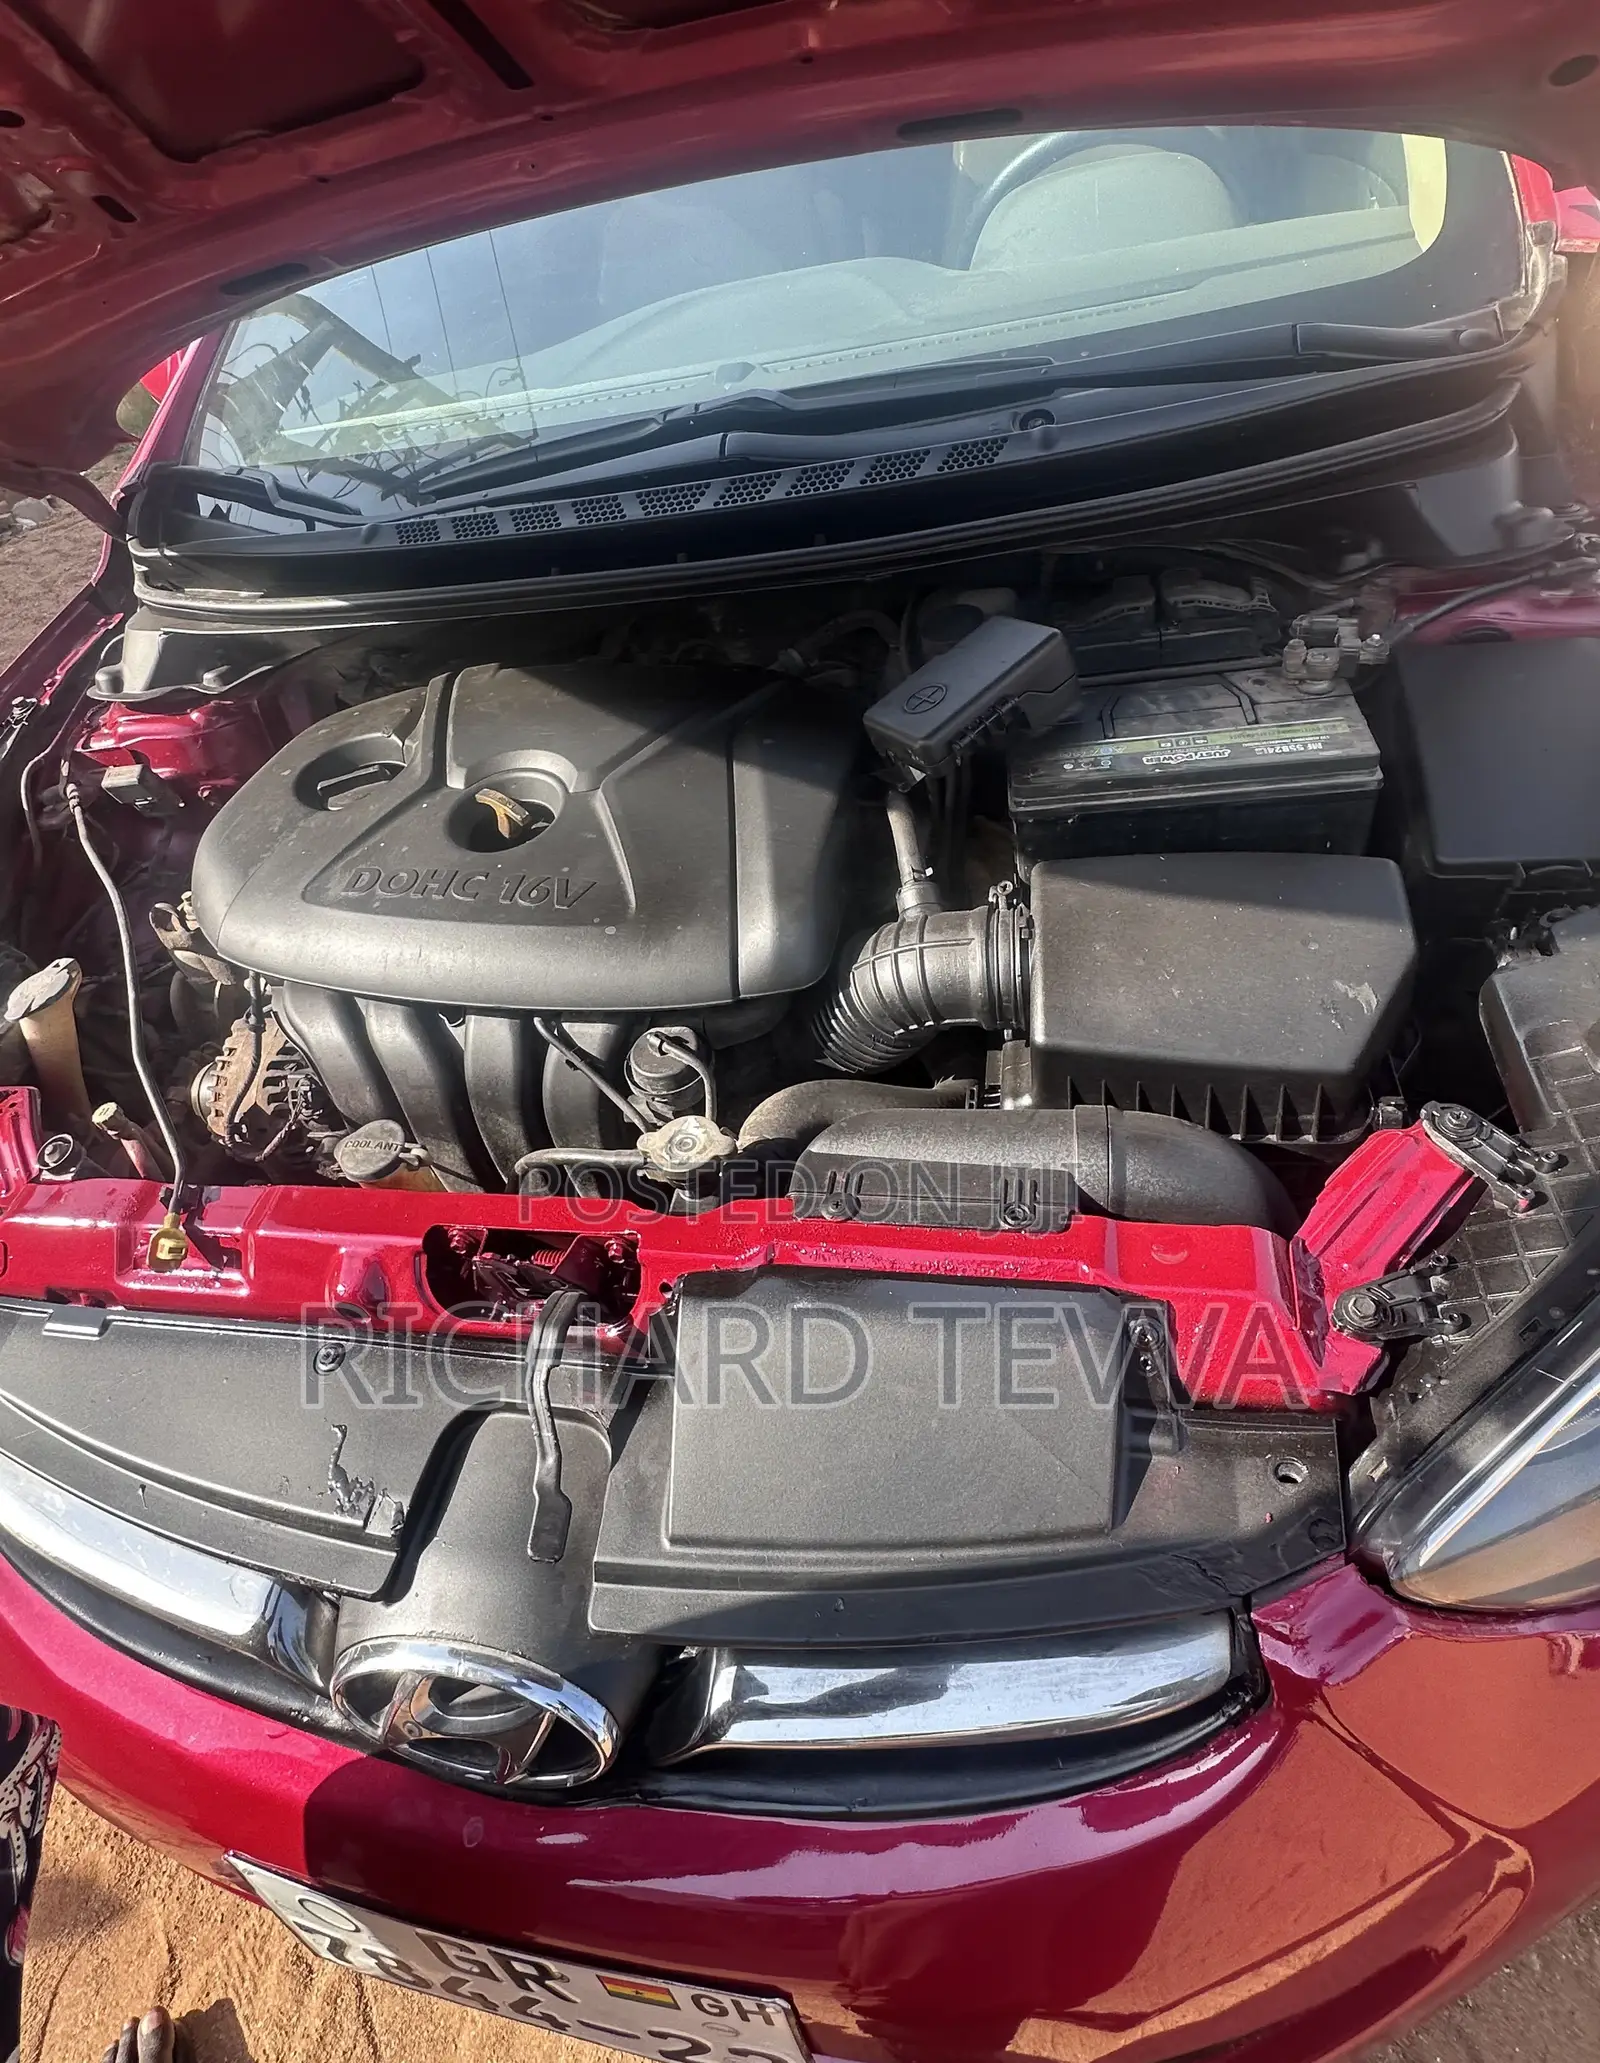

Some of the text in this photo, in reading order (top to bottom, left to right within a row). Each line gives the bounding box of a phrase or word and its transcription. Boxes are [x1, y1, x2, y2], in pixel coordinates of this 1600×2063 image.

[1142, 752, 1196, 765] POWER
[1196, 749, 1231, 760] JUST
[341, 866, 598, 909] DOHC 16V
[344, 1140, 402, 1152] COOLANT
[413, 1930, 775, 2026] GR GH
